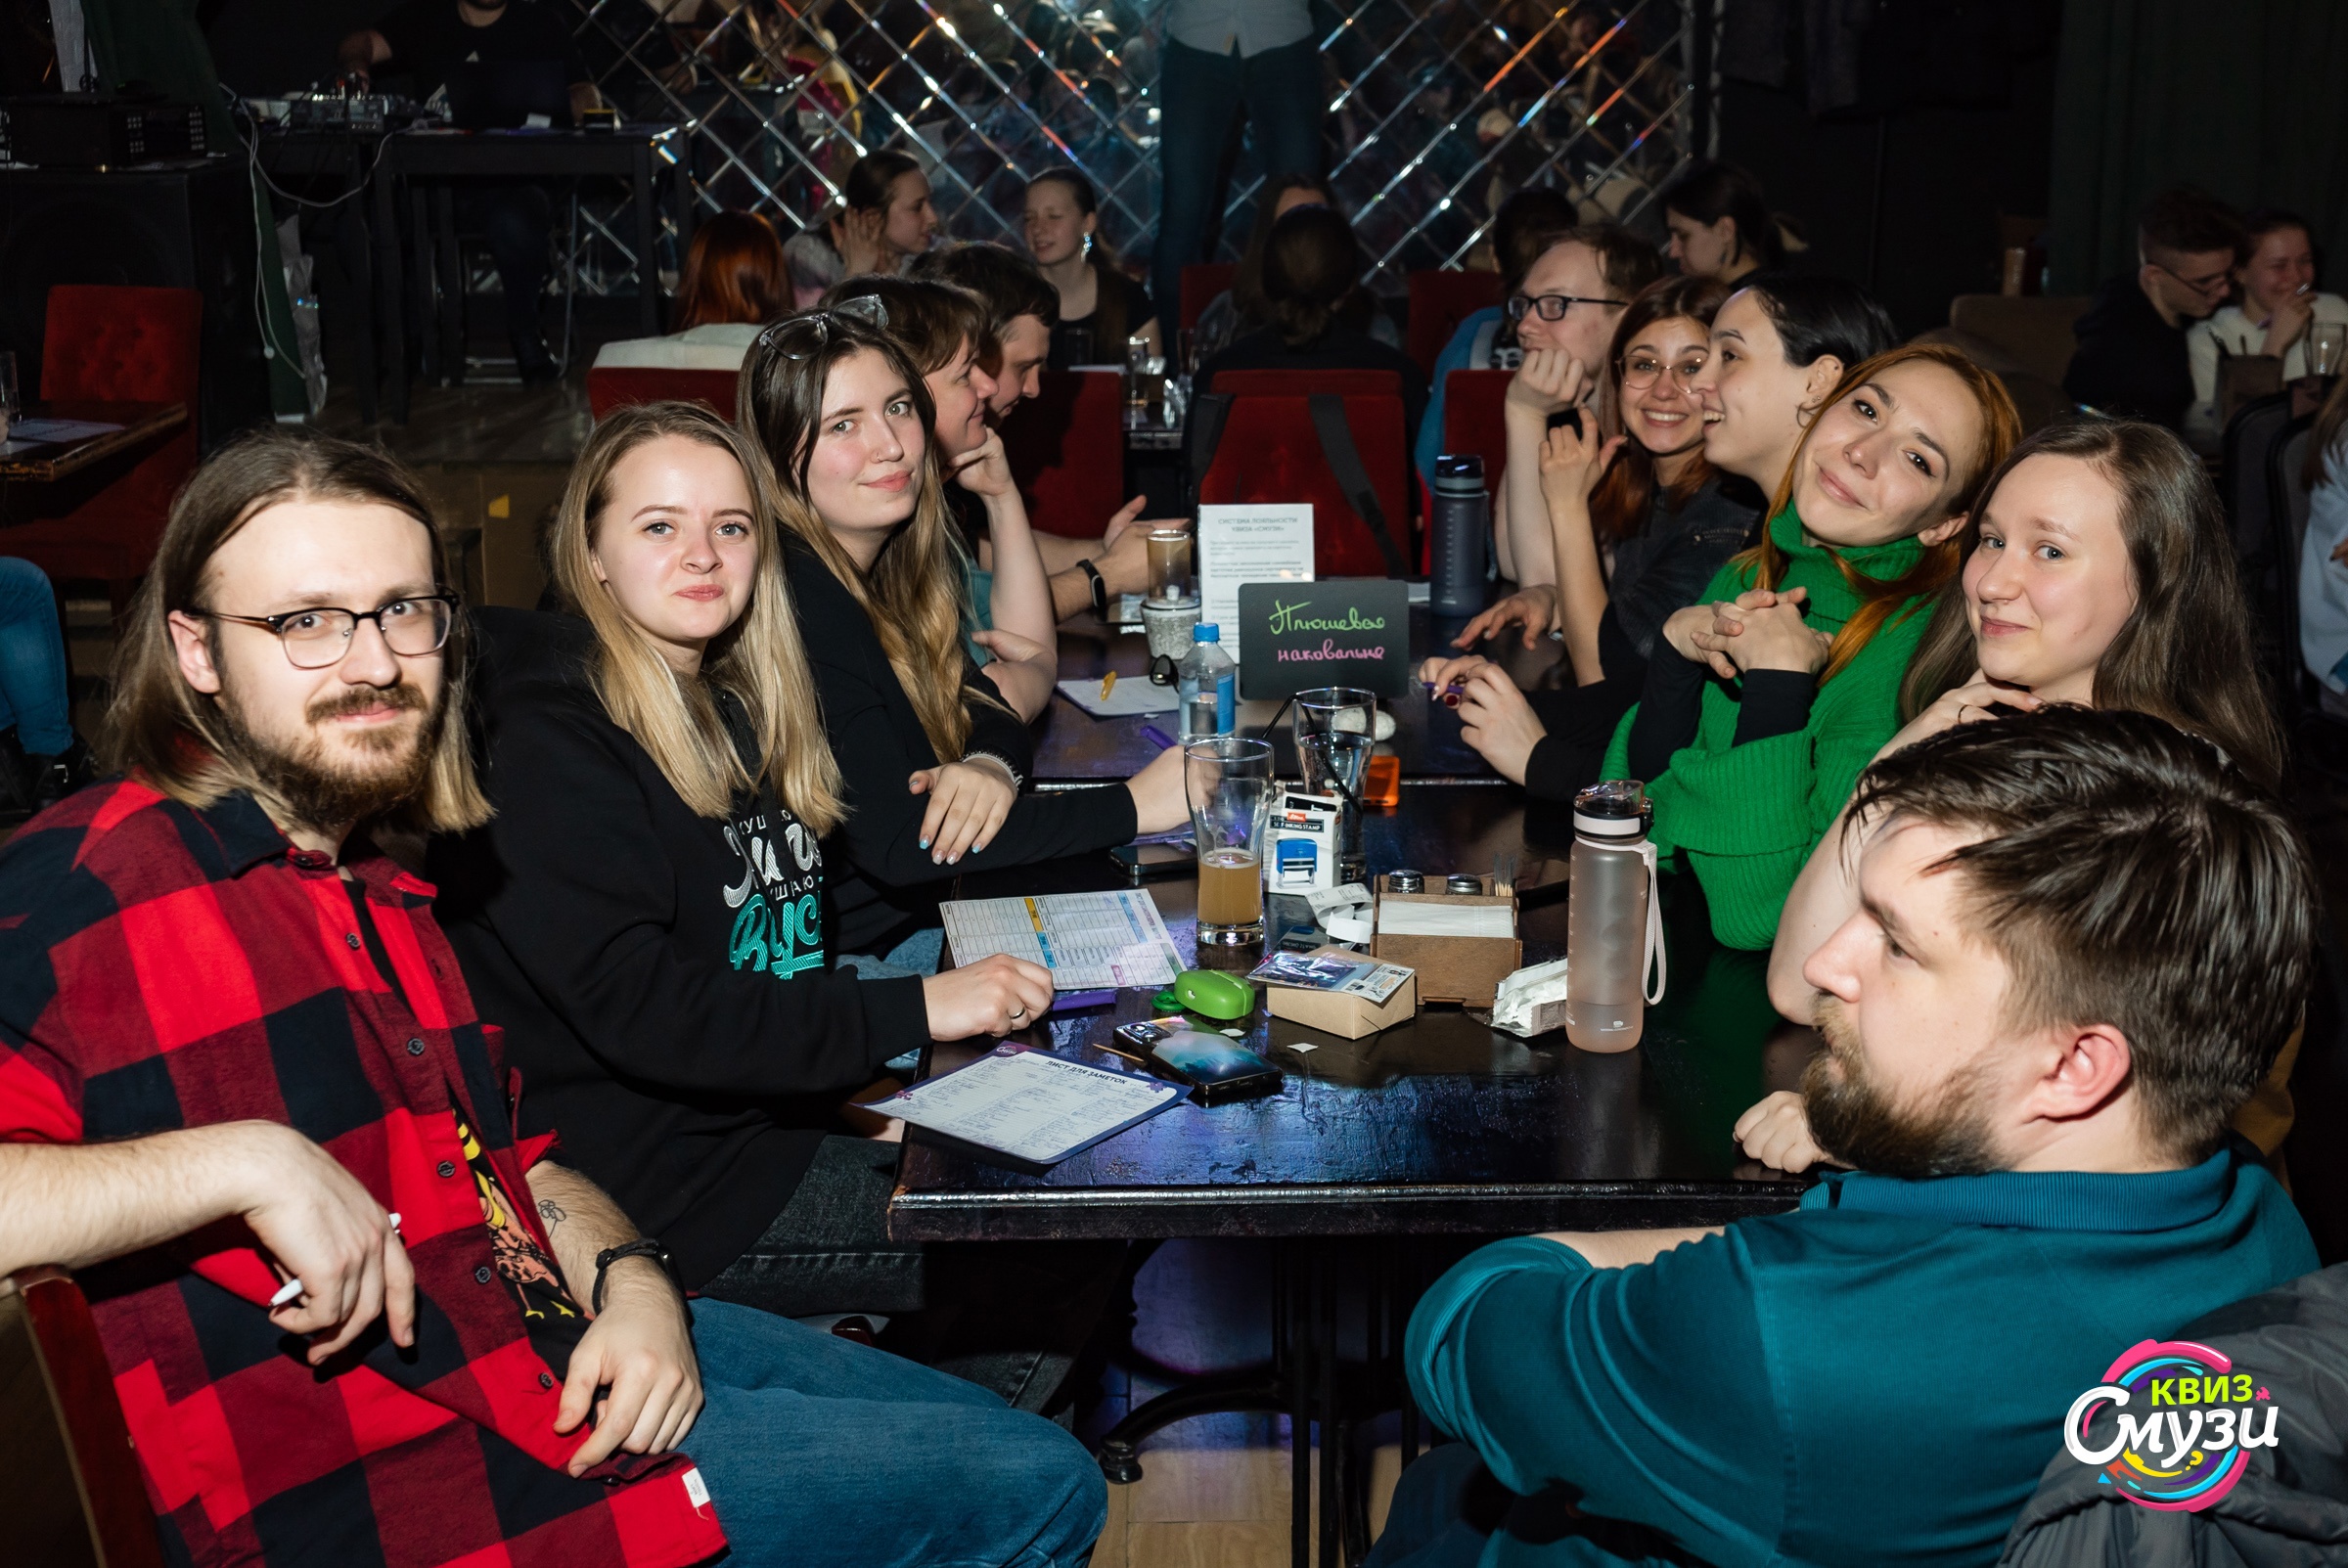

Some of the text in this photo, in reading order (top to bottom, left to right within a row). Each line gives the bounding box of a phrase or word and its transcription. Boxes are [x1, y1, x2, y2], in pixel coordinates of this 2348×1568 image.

[1269, 600, 1385, 635] Плюшевая
[1278, 639, 1385, 662] наковальня
[1045, 1060, 1128, 1085] ЛИСТ ДЛЯ ЗАМЕТОК
